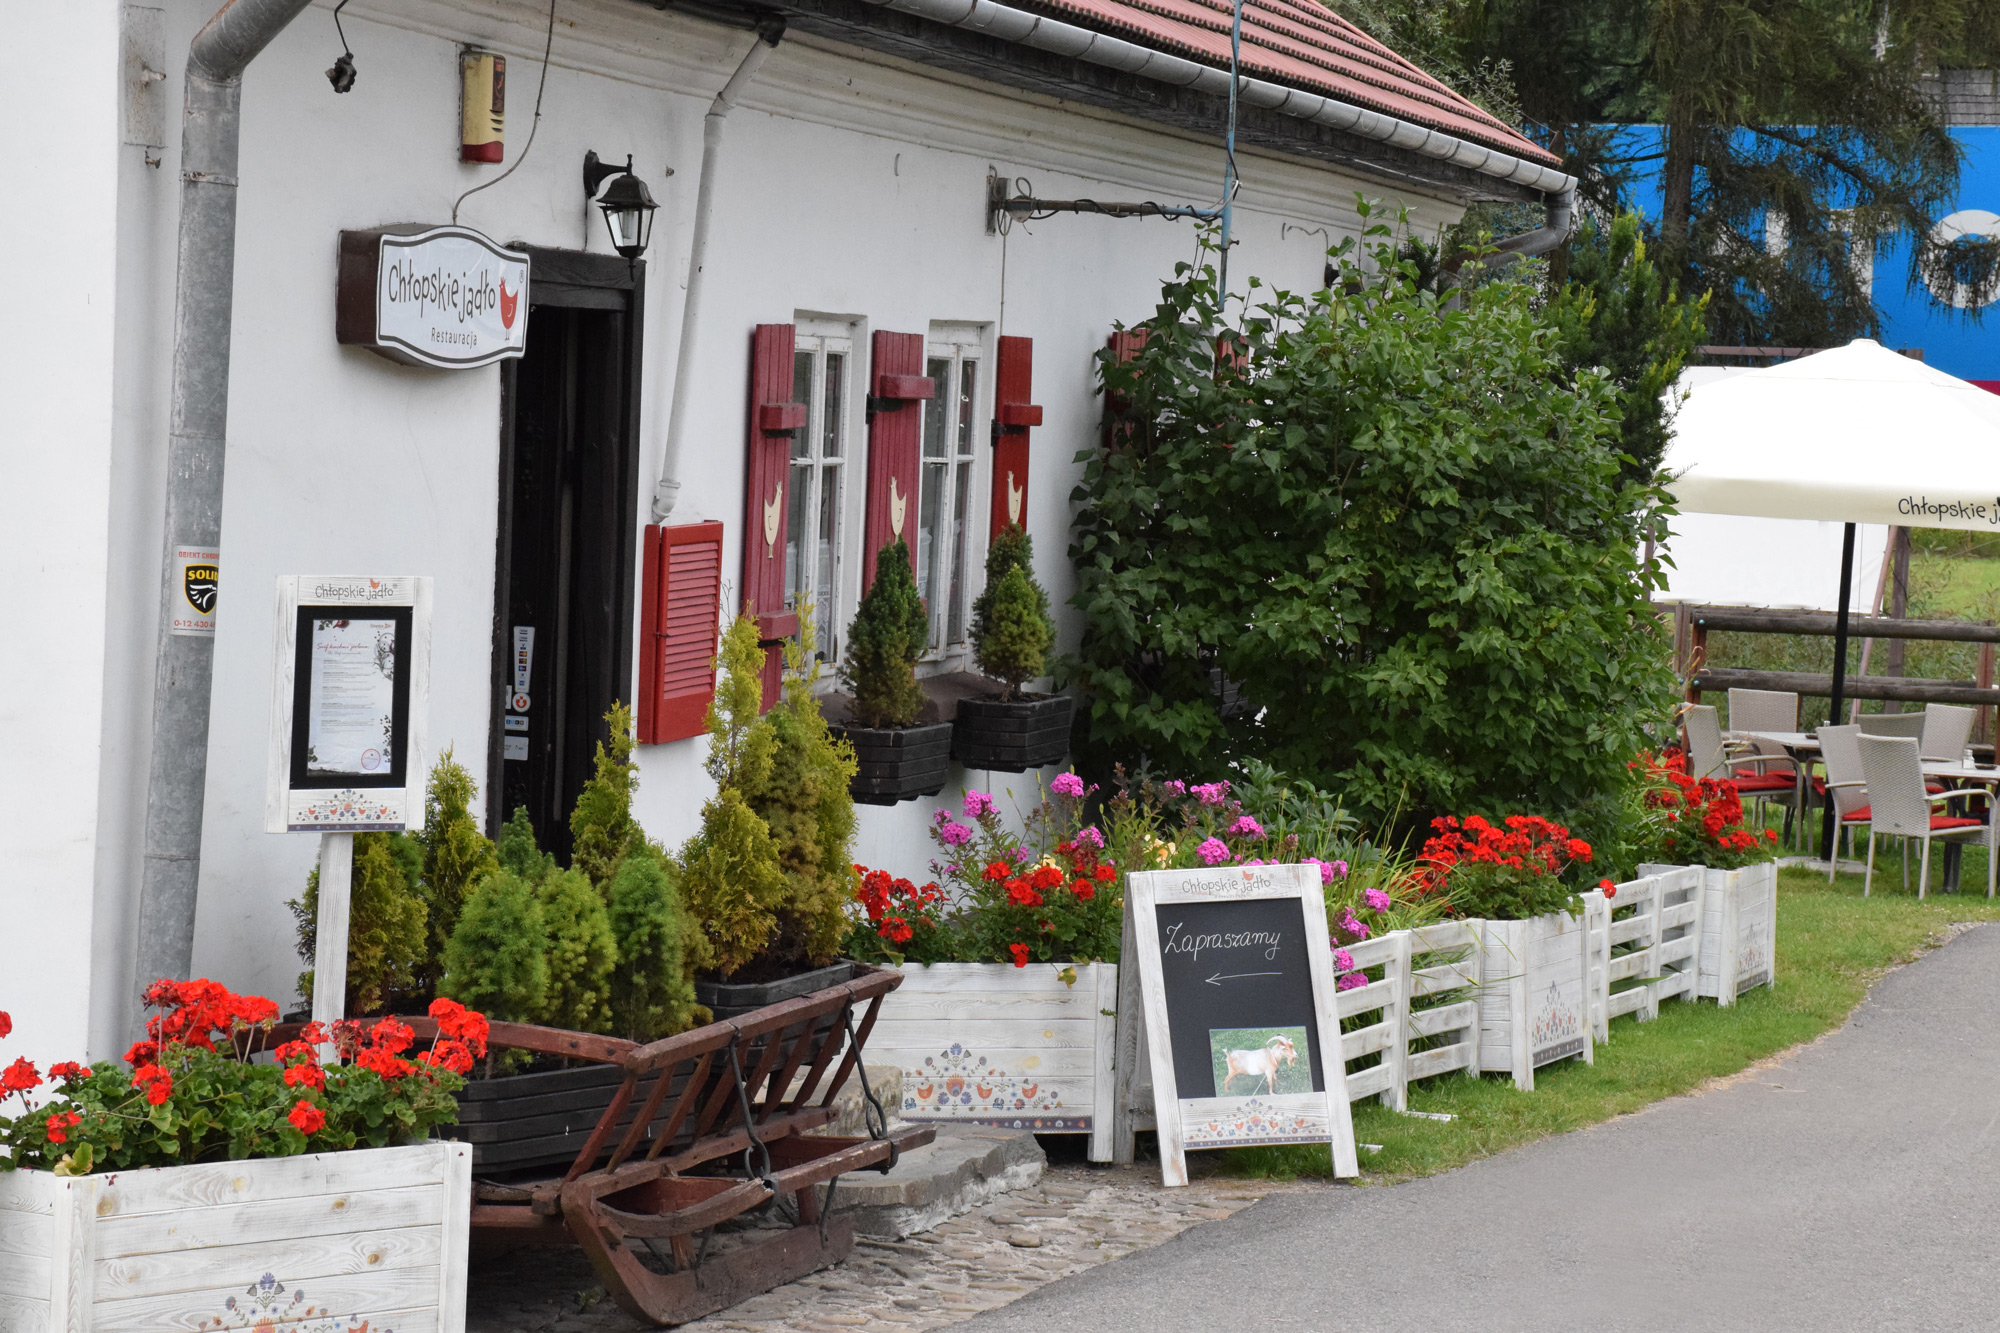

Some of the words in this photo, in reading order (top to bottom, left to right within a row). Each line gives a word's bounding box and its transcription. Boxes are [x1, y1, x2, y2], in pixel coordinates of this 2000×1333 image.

[388, 258, 460, 318] Chłopskie
[458, 269, 497, 324] jadło
[430, 327, 478, 350] Restauracja
[1898, 495, 1986, 522] Chłopskie
[315, 582, 365, 601] Chłopskie
[366, 583, 394, 601] jadło
[1182, 877, 1238, 896] Chłopskie
[1240, 874, 1271, 894] jadło
[1165, 922, 1281, 961] Zapraszamy
